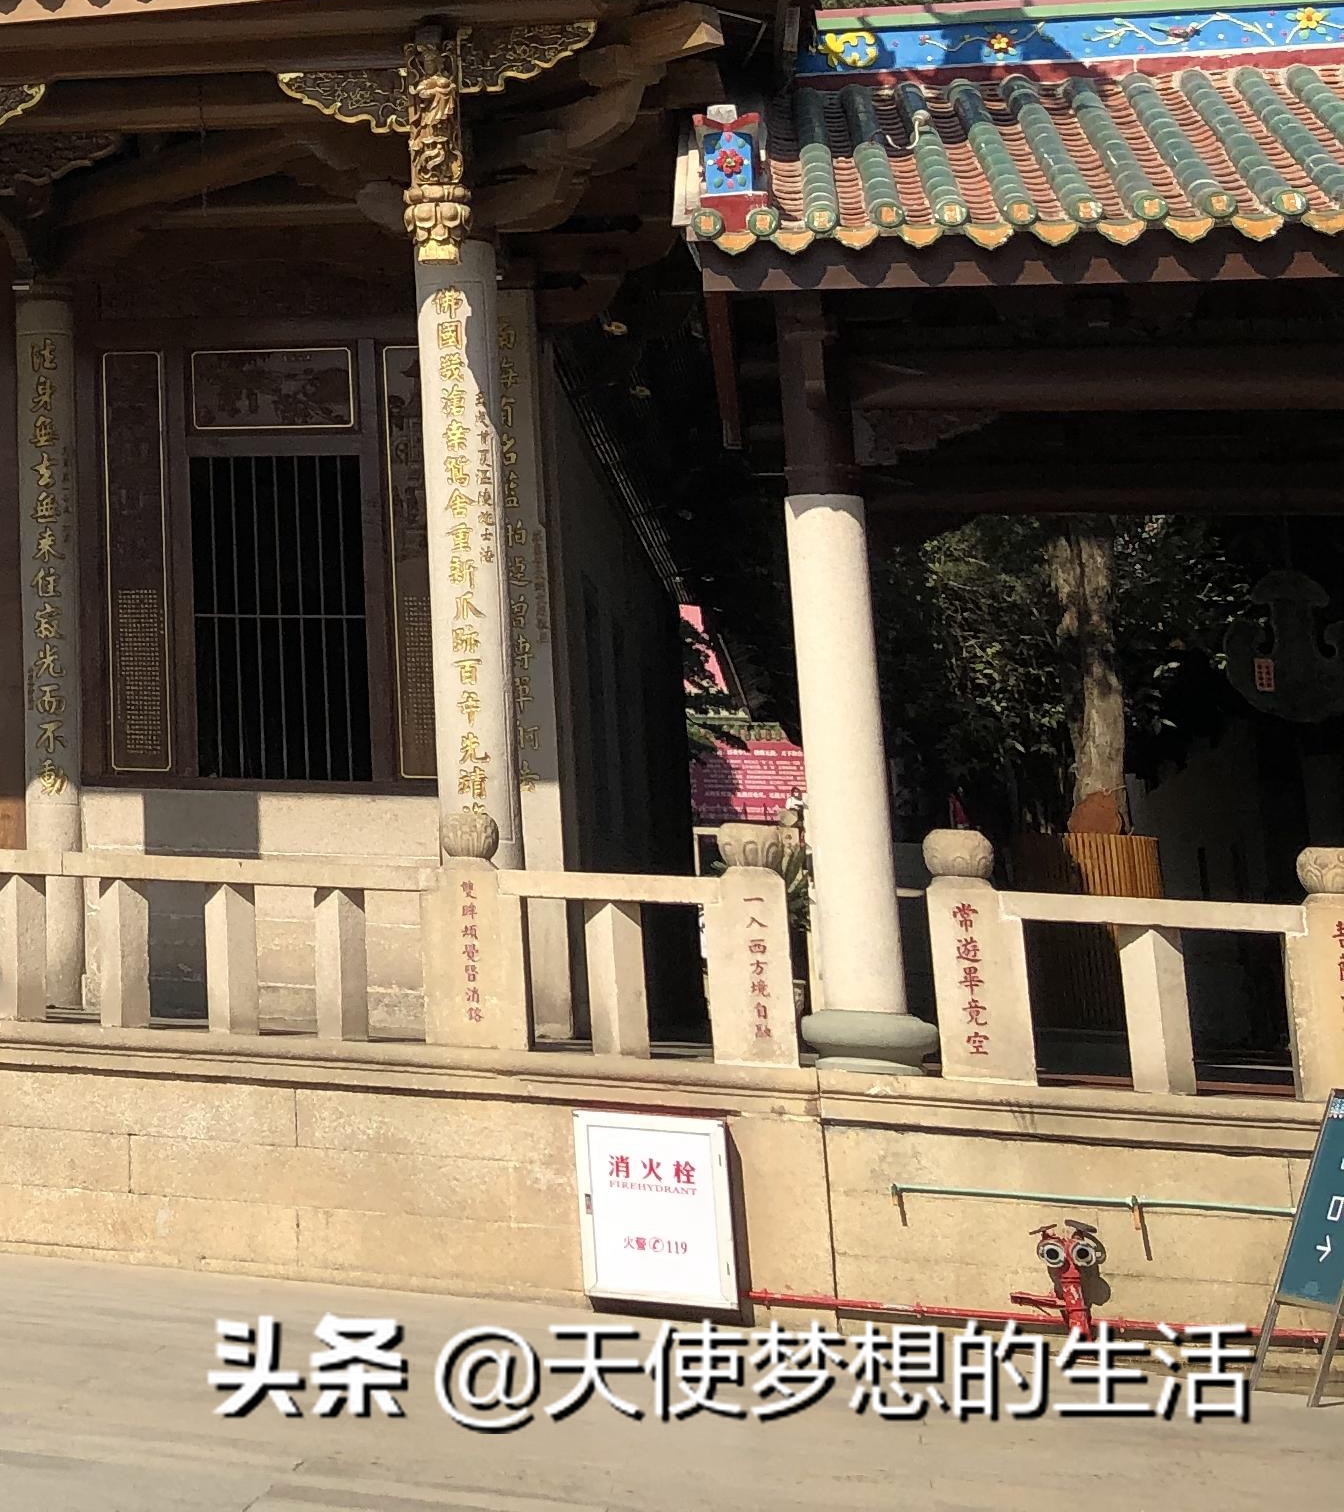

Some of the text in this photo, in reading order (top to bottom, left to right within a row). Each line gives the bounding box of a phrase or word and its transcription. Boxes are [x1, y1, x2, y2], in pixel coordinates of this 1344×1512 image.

[608, 1154, 696, 1185] 消火栓
[667, 1240, 688, 1255] 119
